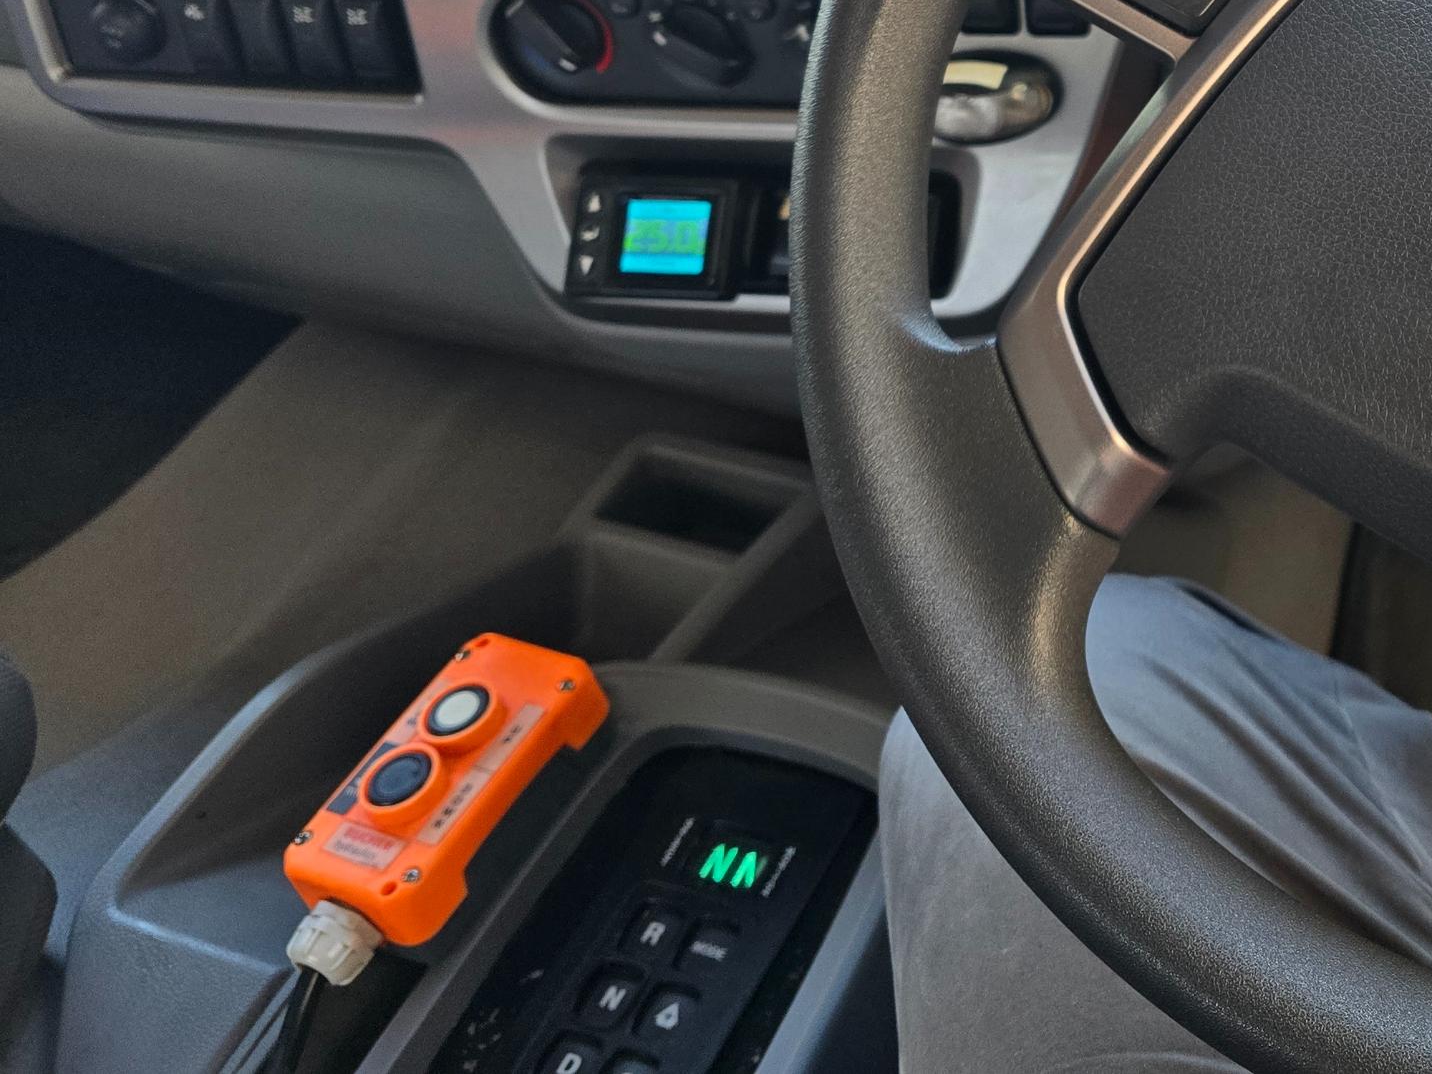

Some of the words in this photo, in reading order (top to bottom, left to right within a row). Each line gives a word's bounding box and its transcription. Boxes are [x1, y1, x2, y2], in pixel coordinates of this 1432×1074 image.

[639, 921, 666, 946] R
[599, 986, 627, 1011] N
[557, 1052, 582, 1074] D
